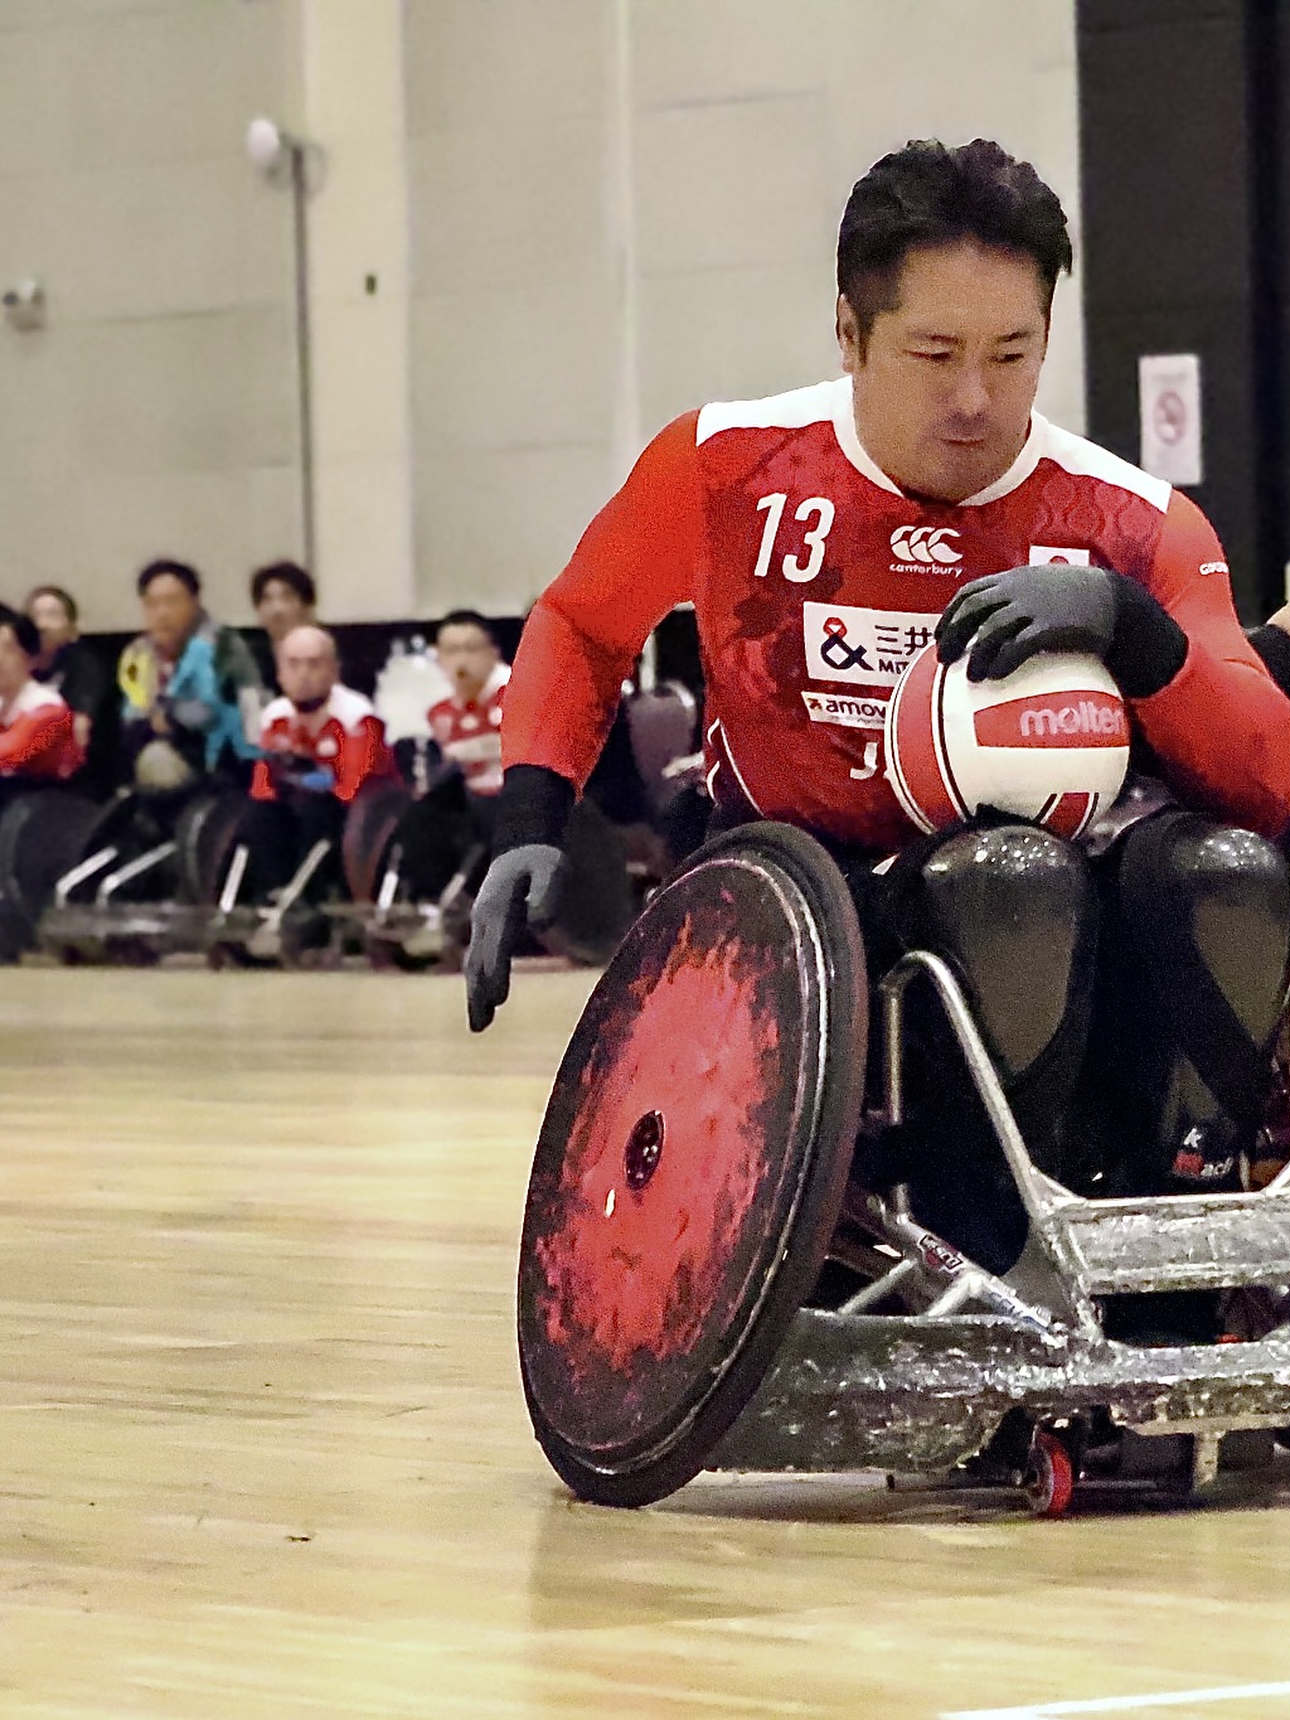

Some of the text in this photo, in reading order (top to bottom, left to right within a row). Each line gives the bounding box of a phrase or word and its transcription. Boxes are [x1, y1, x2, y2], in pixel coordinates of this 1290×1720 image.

[754, 492, 836, 583] 13
[889, 563, 964, 579] canterbury
[874, 624, 933, 656] 三井
